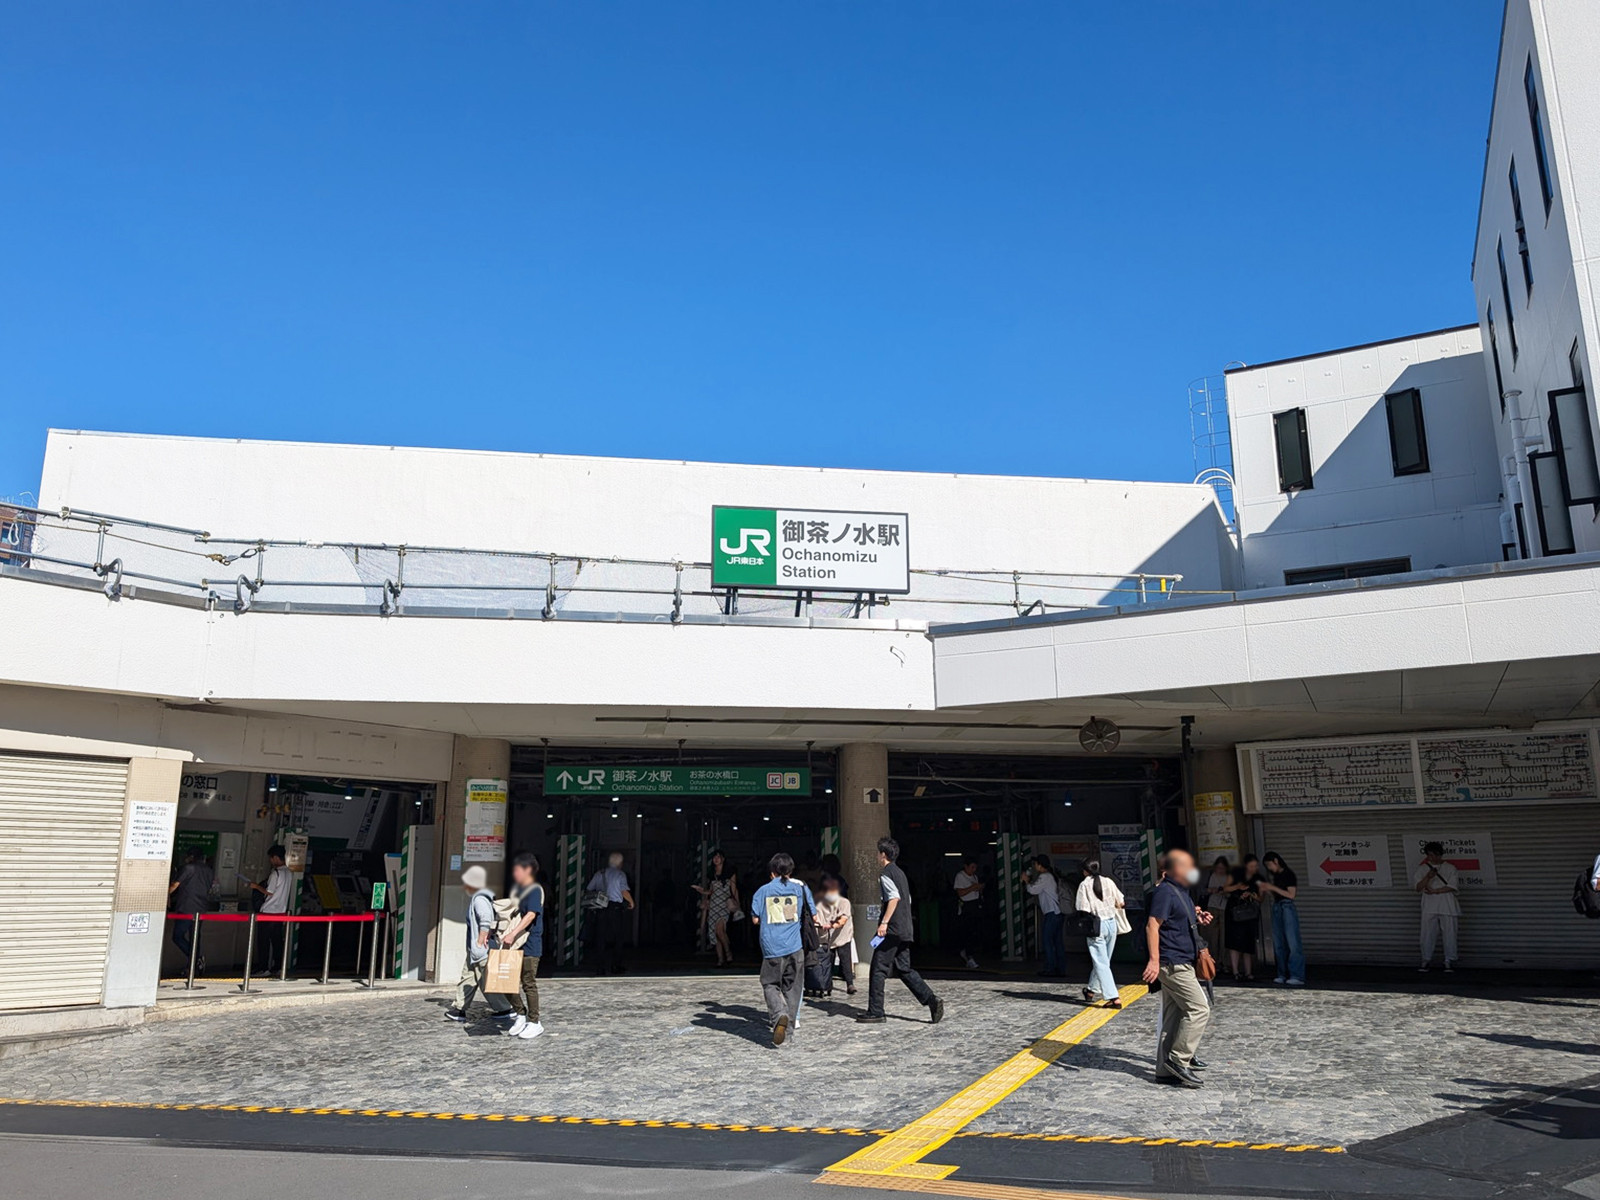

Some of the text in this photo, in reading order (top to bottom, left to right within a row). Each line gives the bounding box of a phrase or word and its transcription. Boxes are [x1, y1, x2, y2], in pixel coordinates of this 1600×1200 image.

[782, 519, 900, 547] 御茶ノ水駅
[719, 528, 771, 556] JR
[782, 547, 878, 563] Ochanomizu
[726, 557, 765, 566] JR東日本
[782, 565, 836, 579] Station
[577, 769, 606, 785] JR
[612, 770, 673, 782] 御茶ノ水駅
[770, 777, 780, 785] JC
[787, 777, 797, 785] JB
[611, 783, 684, 791] Ochanomizu Station
[1326, 878, 1375, 886] 左側にあります
